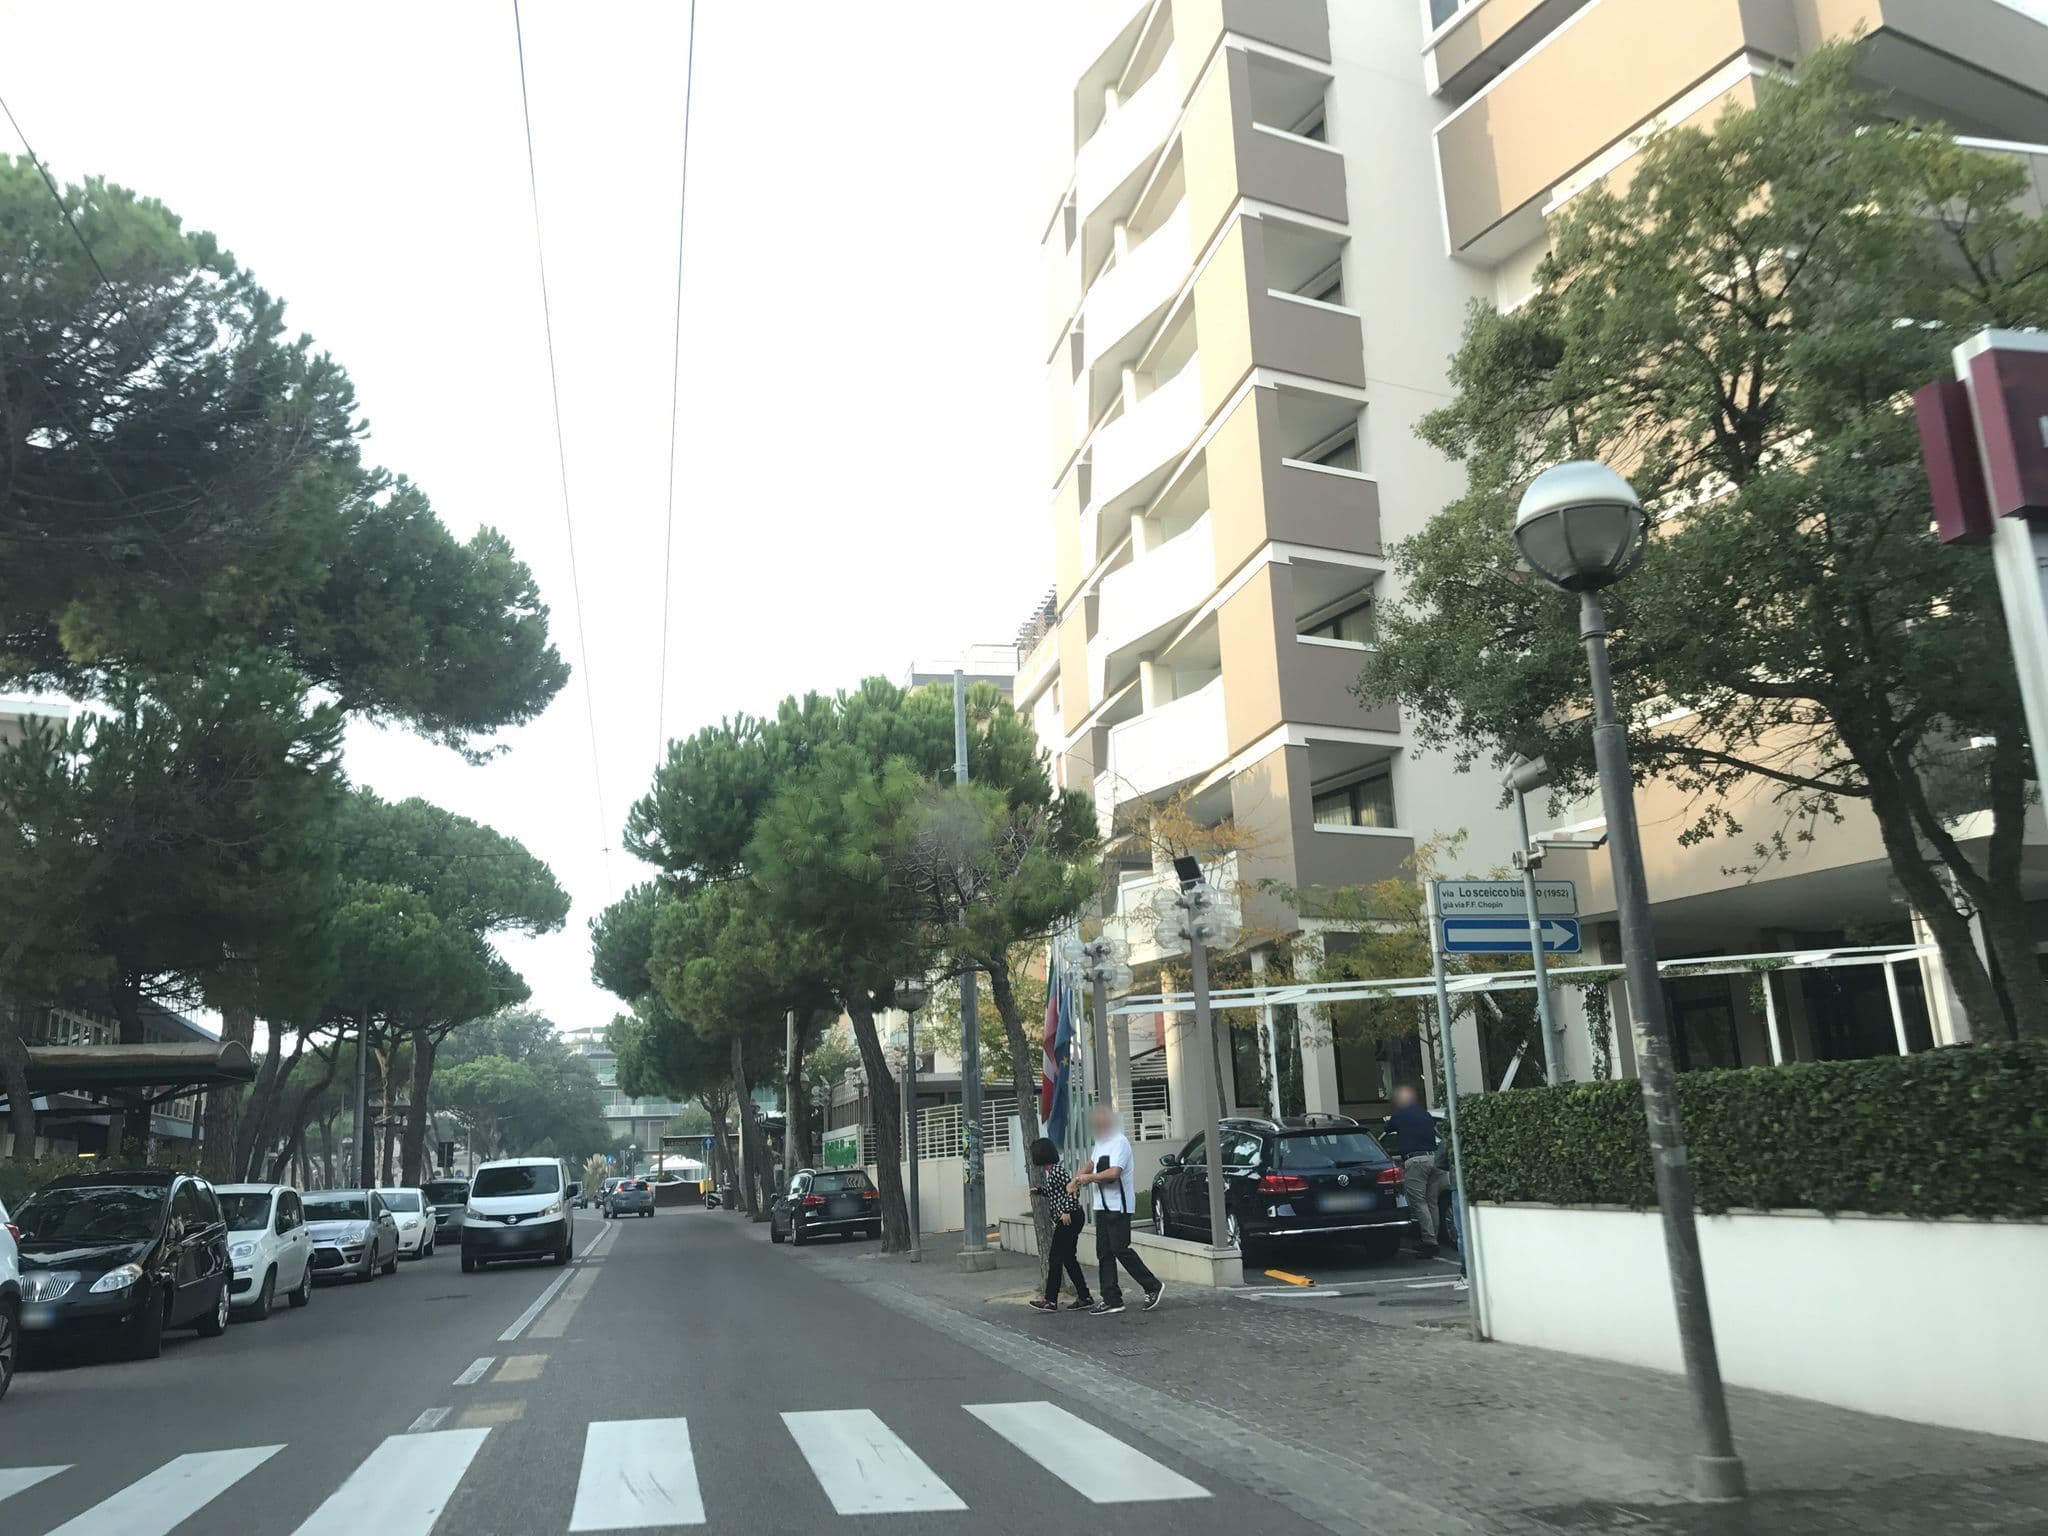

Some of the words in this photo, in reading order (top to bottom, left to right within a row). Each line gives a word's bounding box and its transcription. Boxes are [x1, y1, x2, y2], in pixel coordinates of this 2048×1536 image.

[1441, 889, 1454, 898] via
[1459, 887, 1471, 898] Lo
[1472, 886, 1509, 898] sceicco
[1510, 886, 1542, 898] biao
[1543, 888, 1569, 899] (1952)
[1478, 901, 1503, 909] Chopin
